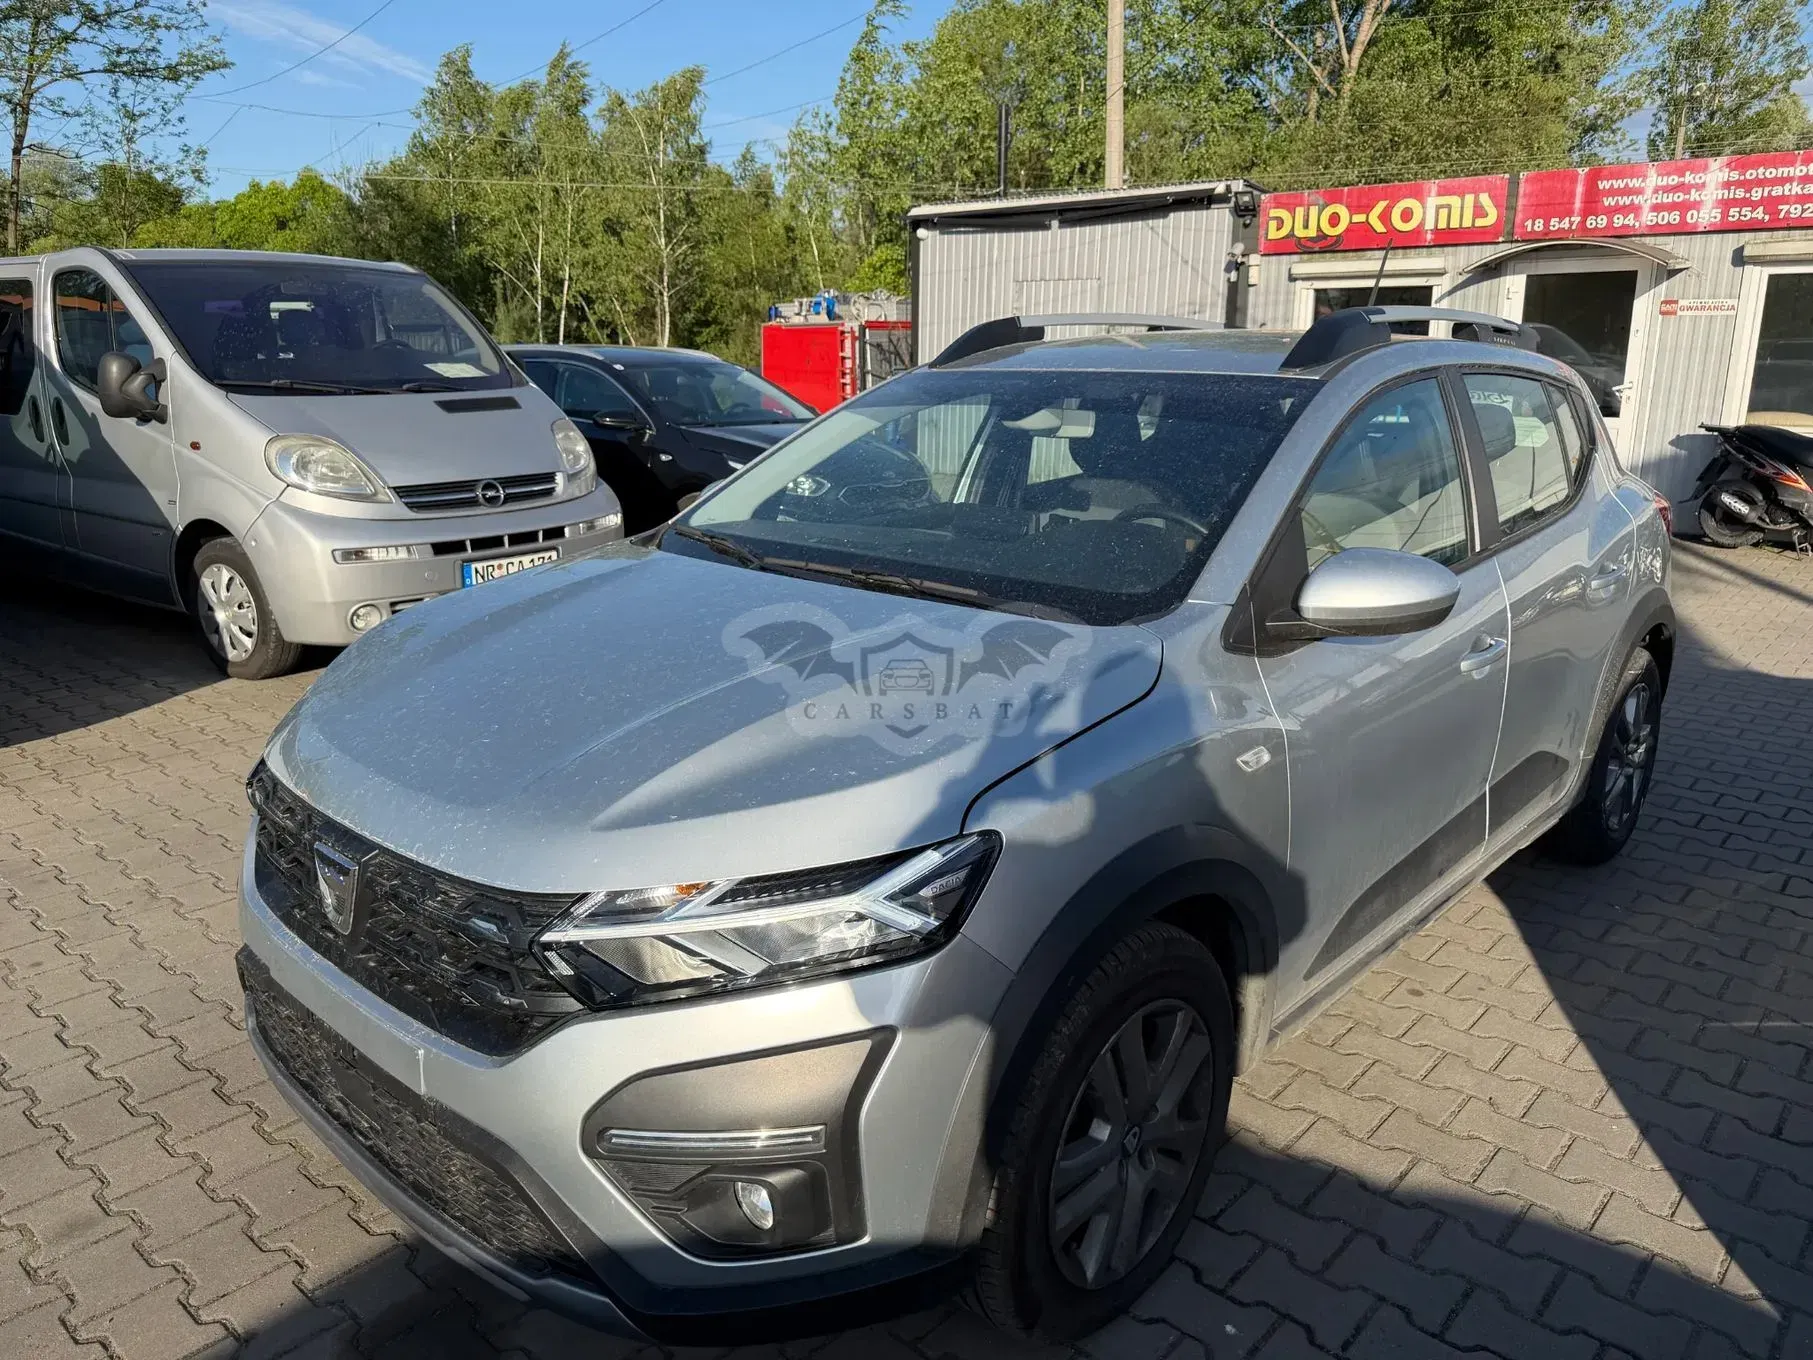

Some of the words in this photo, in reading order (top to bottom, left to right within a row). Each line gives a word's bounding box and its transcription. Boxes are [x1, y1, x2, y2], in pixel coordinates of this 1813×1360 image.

[1524, 218, 1544, 232] 18
[1549, 216, 1581, 231] 547
[1586, 215, 1608, 229] 69
[1612, 212, 1640, 228] 94,
[1646, 210, 1681, 226] 506
[1686, 208, 1722, 224] 055
[1727, 206, 1770, 223] 554,
[1777, 203, 1813, 219] 792
[1679, 304, 1736, 312] GWARANCJA
[474, 564, 495, 584] NR
[505, 560, 525, 575] CA
[930, 876, 961, 894] DACIA
